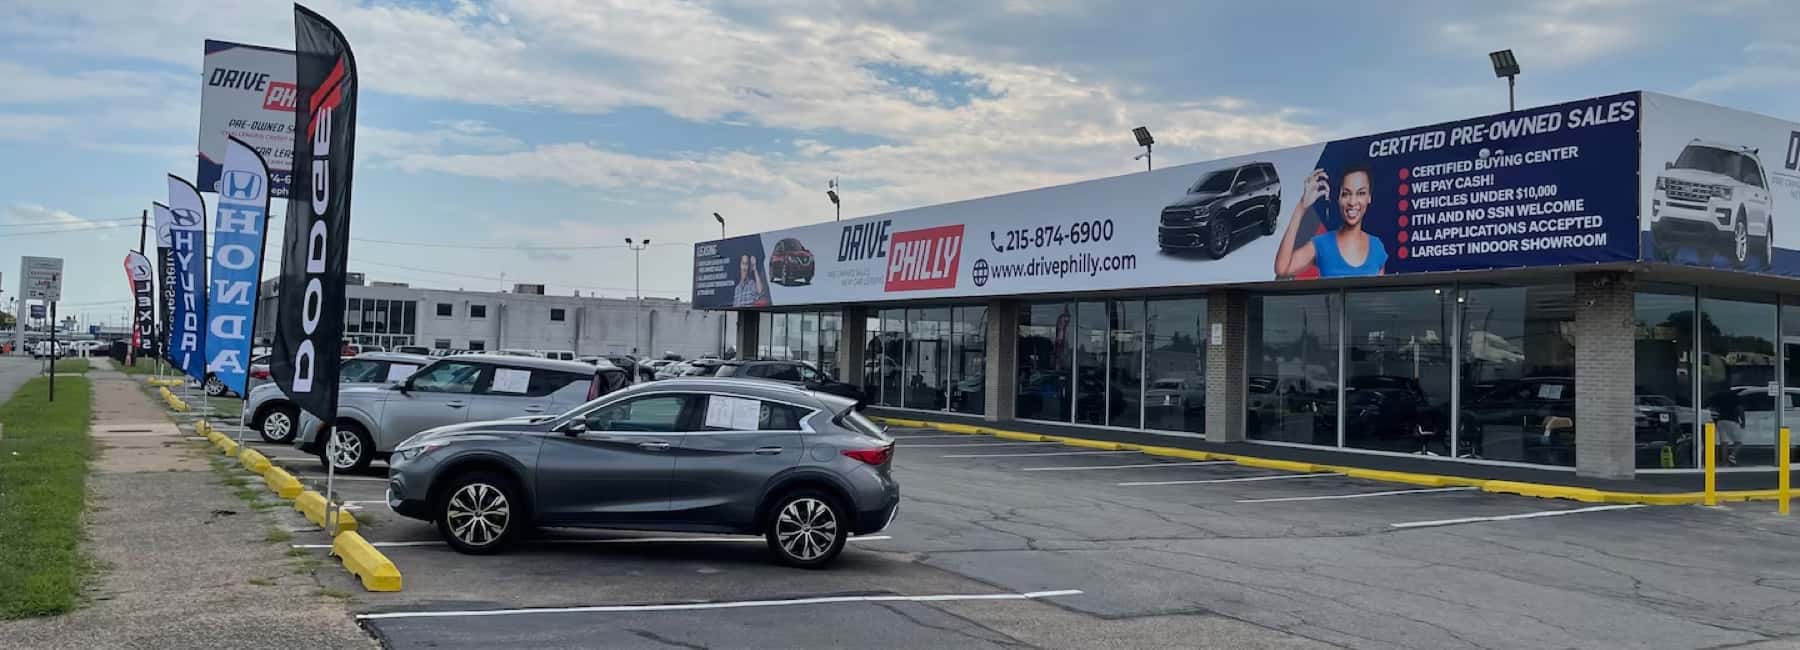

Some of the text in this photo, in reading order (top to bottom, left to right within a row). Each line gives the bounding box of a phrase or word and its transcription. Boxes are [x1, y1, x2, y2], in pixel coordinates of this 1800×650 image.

[208, 68, 270, 92] DRIVE
[229, 119, 285, 133] PRE-OWNED
[1369, 100, 1636, 157] CERTFIED PRE-OWNED SALES
[1412, 146, 1579, 178] CERTIFIED BUYING CENTER
[1411, 174, 1495, 194] WE PAY CASH!
[1411, 184, 1557, 210] VEHICLES UNDER $10,000
[1412, 199, 1584, 226] ITIN AND NO SSN WELCOME
[837, 220, 892, 262] DRIVE
[1006, 218, 1114, 251] 215-874-6900
[1411, 215, 1603, 242] ALL APPLICATIONS ACCEPTED
[1412, 233, 1607, 257] LARGEST INDOOR SHOWROOM
[887, 235, 961, 283] PHILLY
[991, 252, 1137, 279] www.drivephilly.com
